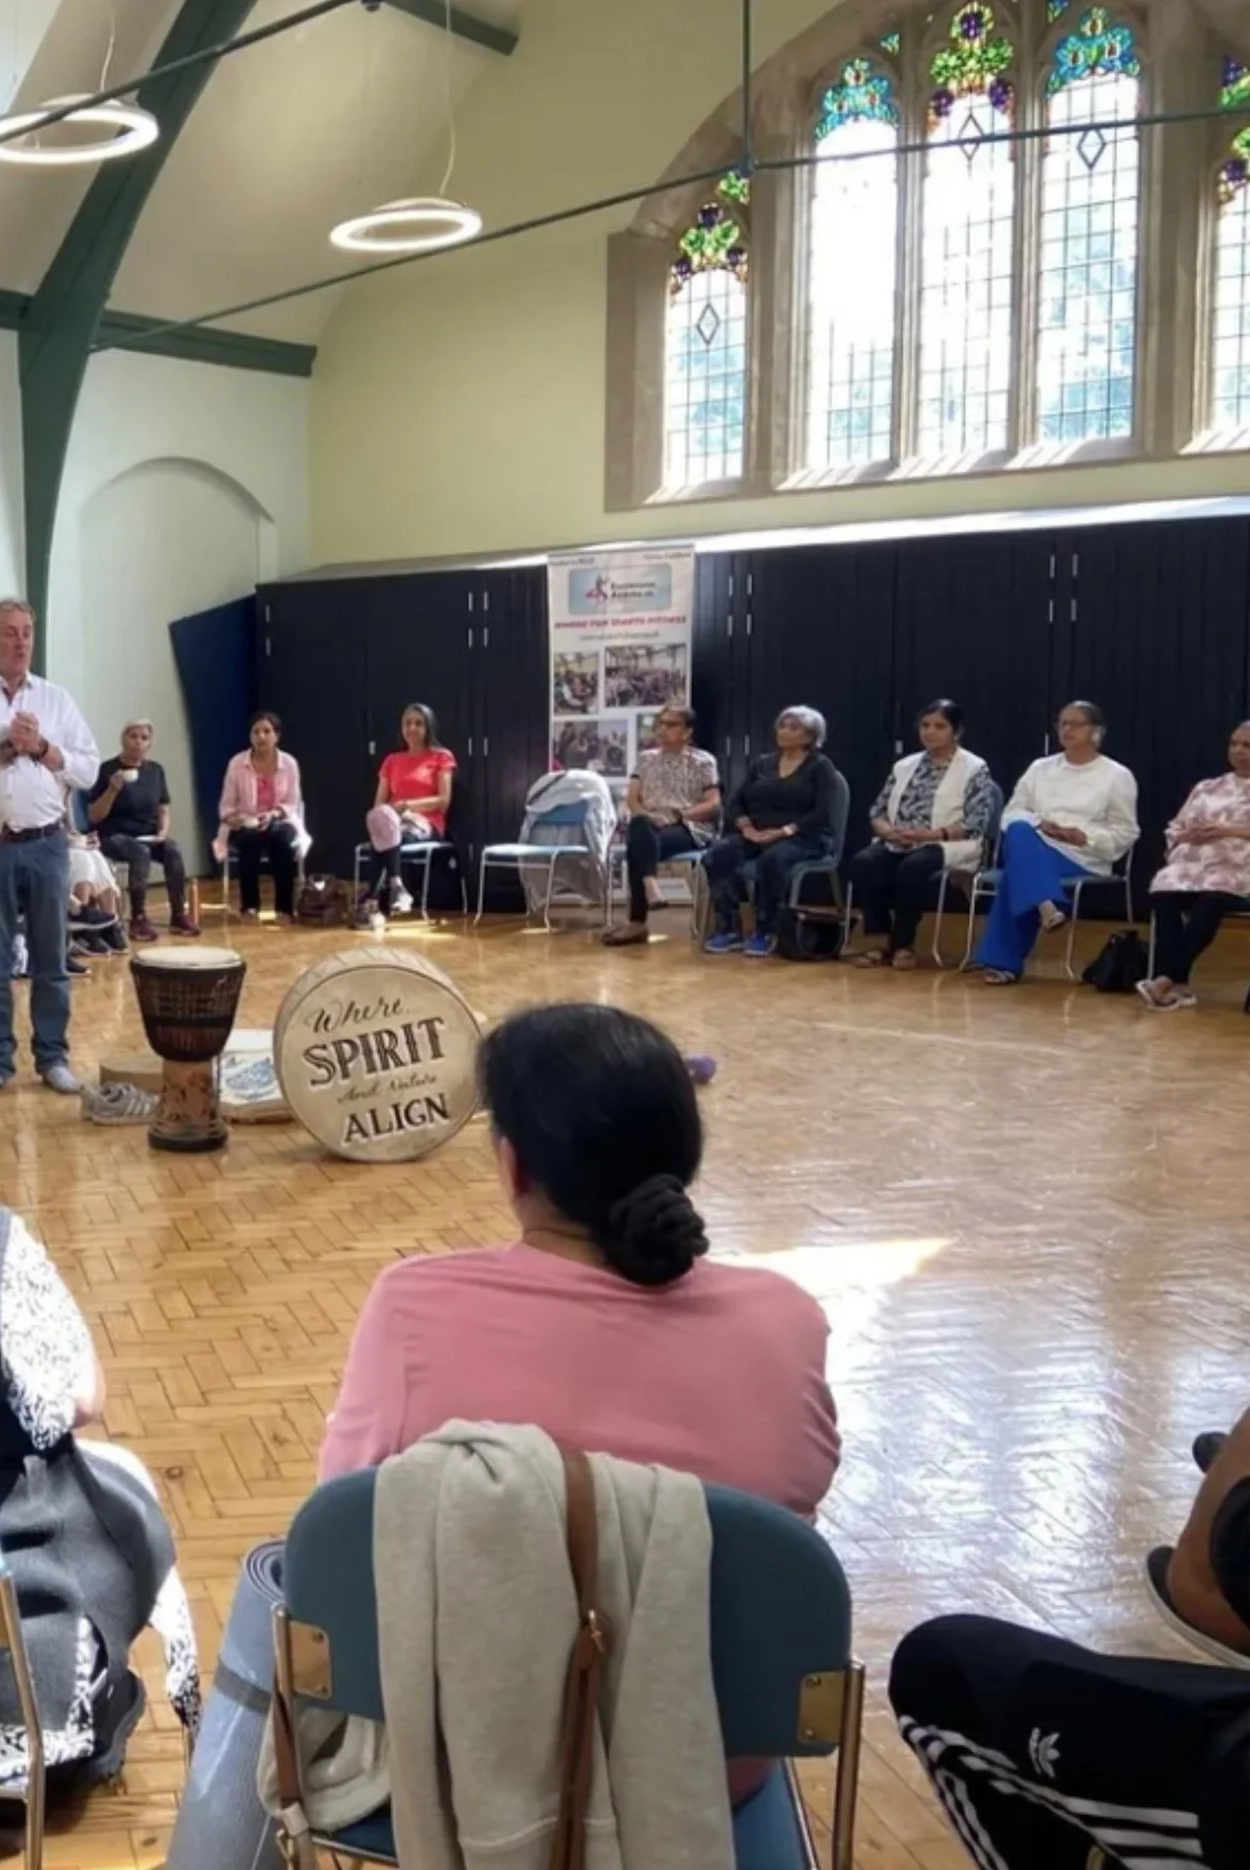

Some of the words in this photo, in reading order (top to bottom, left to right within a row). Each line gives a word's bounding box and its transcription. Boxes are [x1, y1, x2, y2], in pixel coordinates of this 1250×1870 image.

[305, 996, 403, 1033] Where
[302, 1016, 445, 1086] SPIRIT
[344, 1093, 450, 1142] ALIGN
